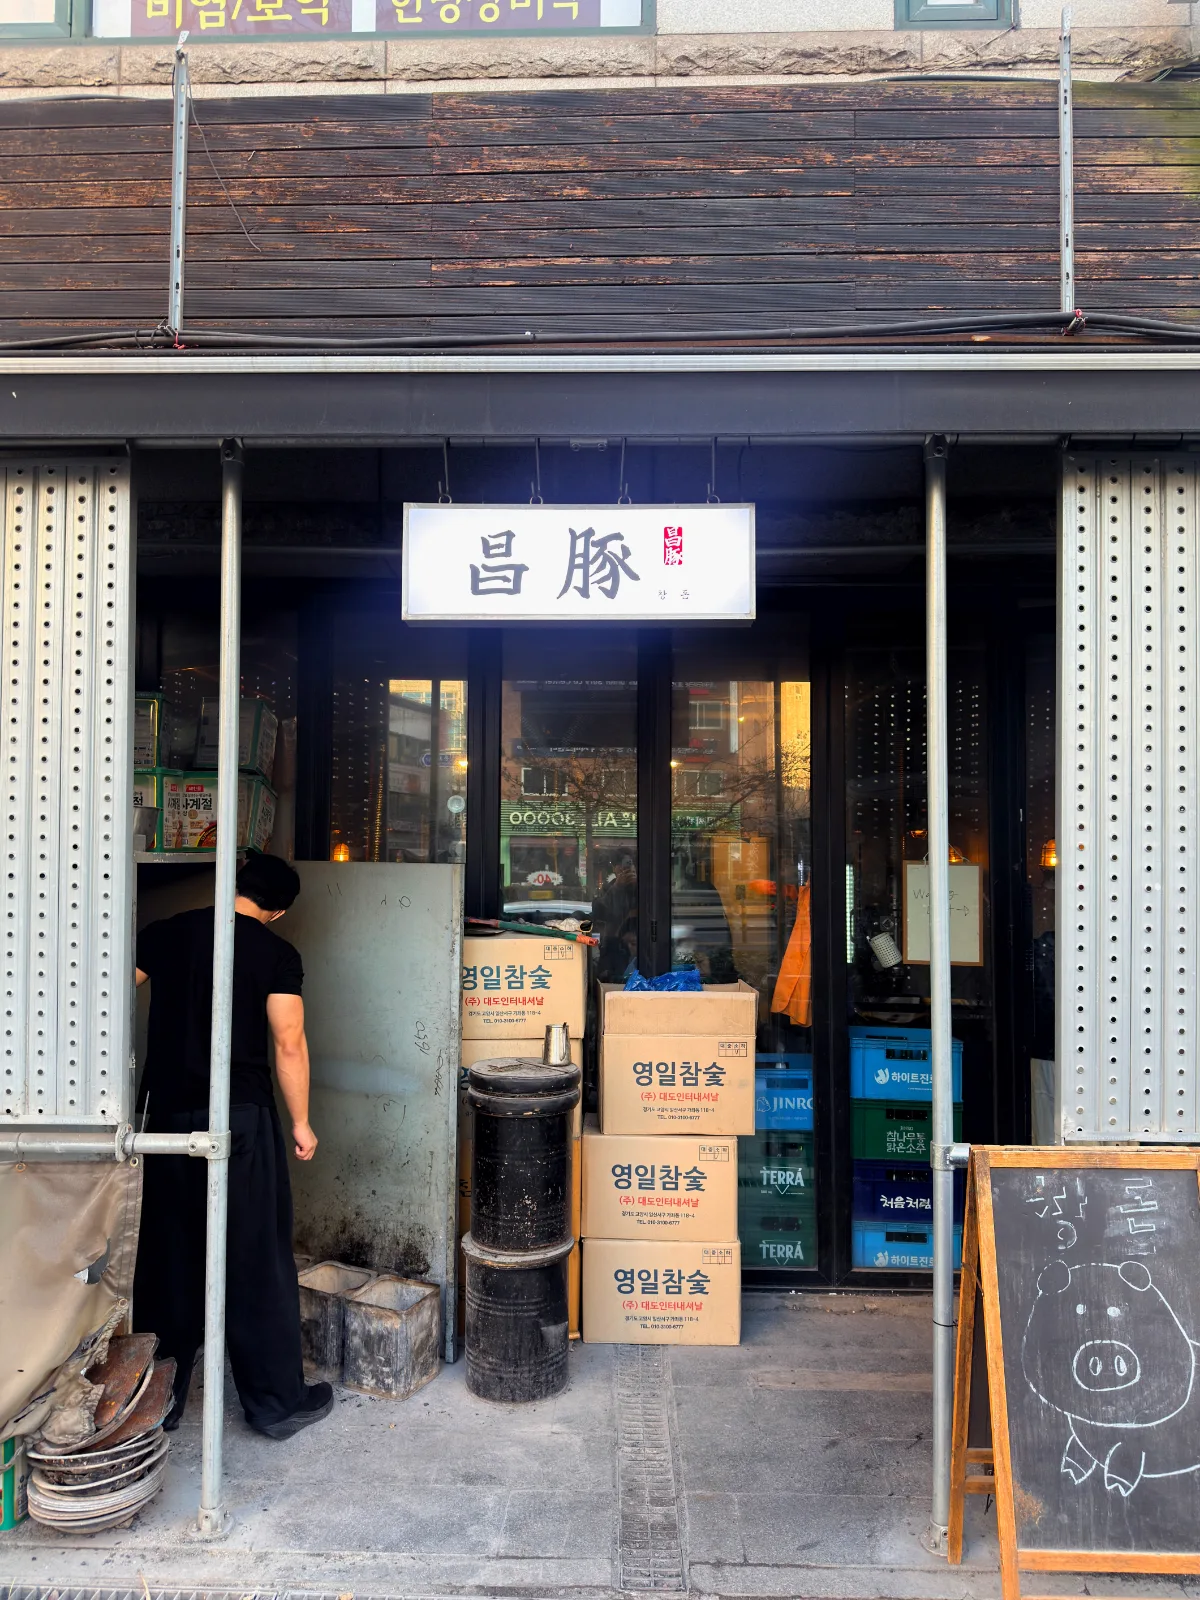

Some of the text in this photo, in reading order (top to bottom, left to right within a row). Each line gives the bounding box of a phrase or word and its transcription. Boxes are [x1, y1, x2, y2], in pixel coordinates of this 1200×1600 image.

[469, 527, 641, 600] 昌豚
[463, 965, 552, 991] 영일참숯
[464, 996, 481, 1007] (주)
[632, 1061, 727, 1087] 영일참숯
[640, 1092, 657, 1102] (주)
[886, 1130, 926, 1144] 참나무통
[886, 1142, 927, 1155] 맑은소주
[611, 1164, 708, 1192] 영일참숯
[759, 1167, 806, 1187] TERRA
[619, 1195, 635, 1206] (주)
[879, 1195, 932, 1210] 처음처럼
[759, 1241, 804, 1261] TERRA
[614, 1268, 711, 1295] 영일참숯
[622, 1300, 638, 1311] (주)
